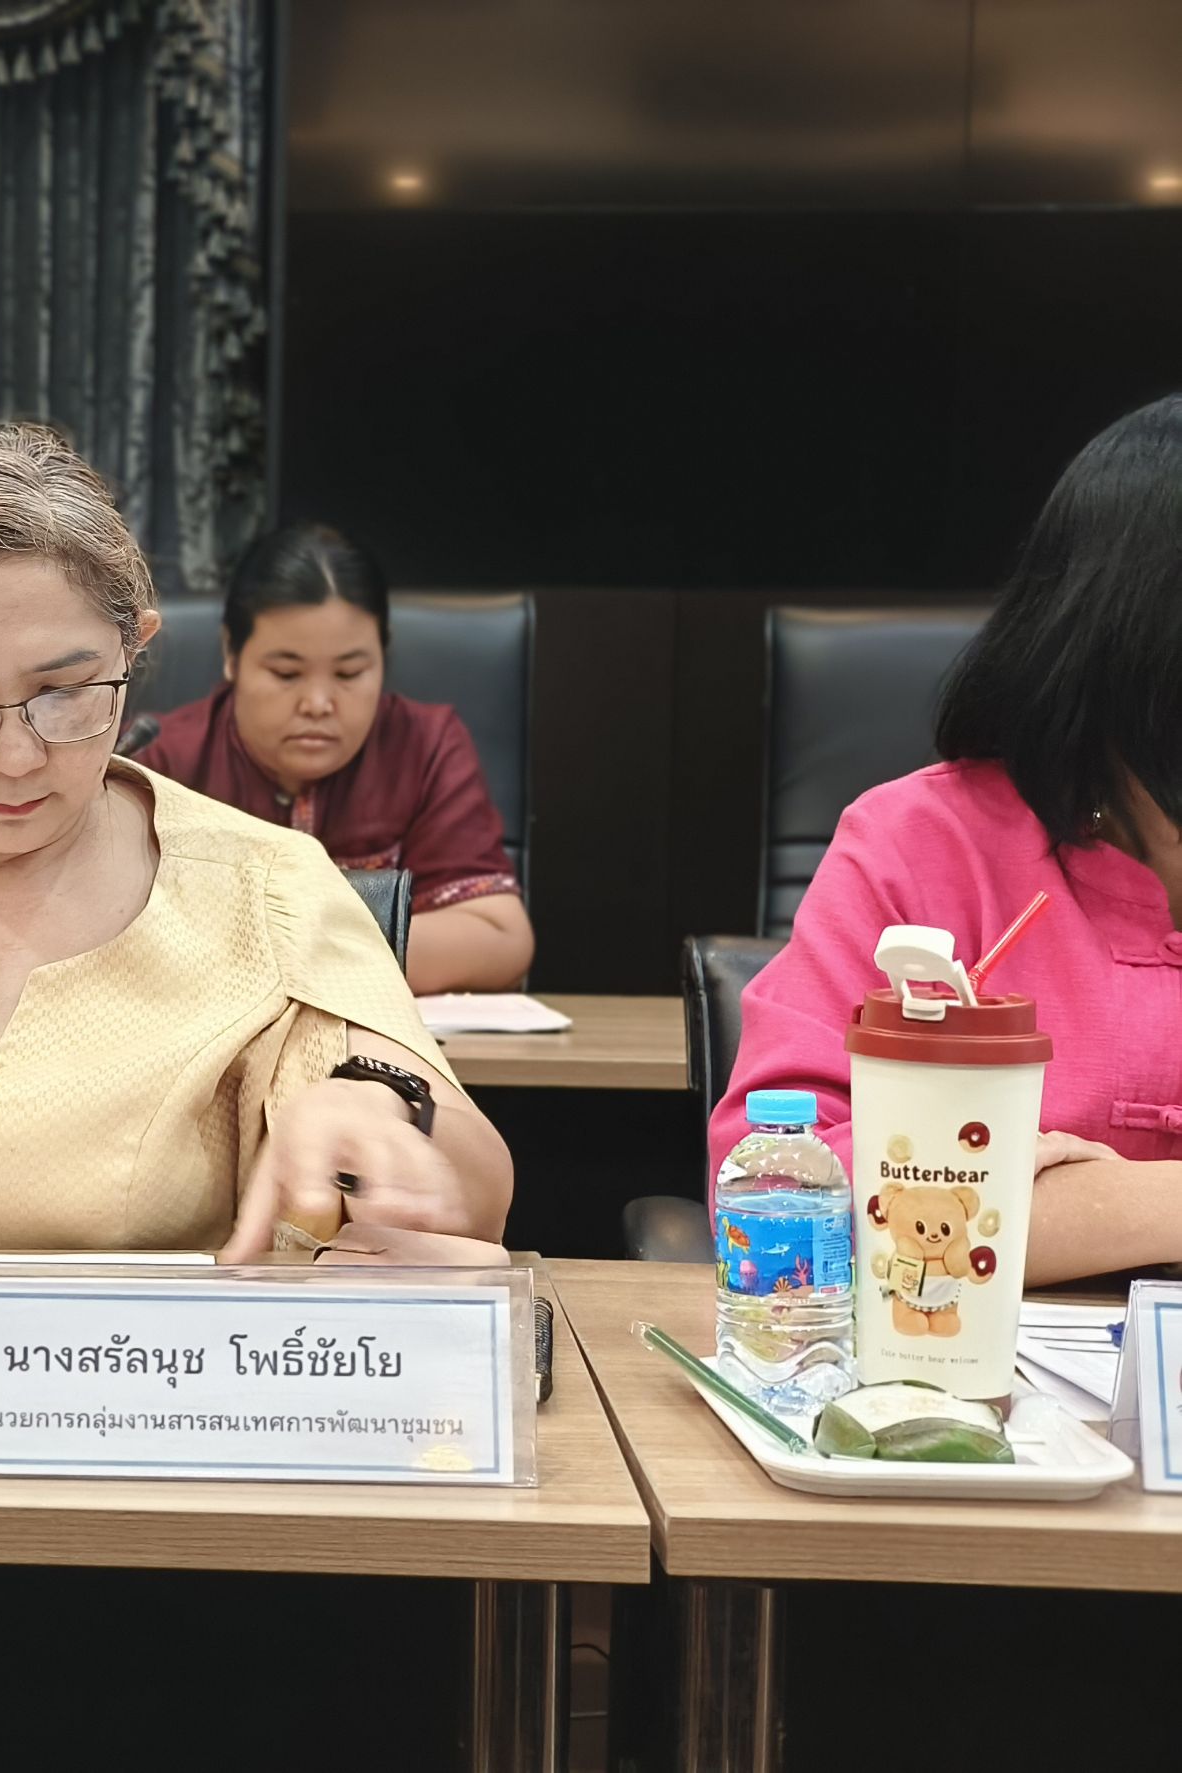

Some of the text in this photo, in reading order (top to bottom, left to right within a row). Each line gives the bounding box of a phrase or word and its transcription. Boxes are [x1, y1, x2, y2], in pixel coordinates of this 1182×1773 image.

[880, 1160, 989, 1183] Butterbear
[3, 1325, 402, 1389] นางสรัลนุช โพธิ์ชัยโย
